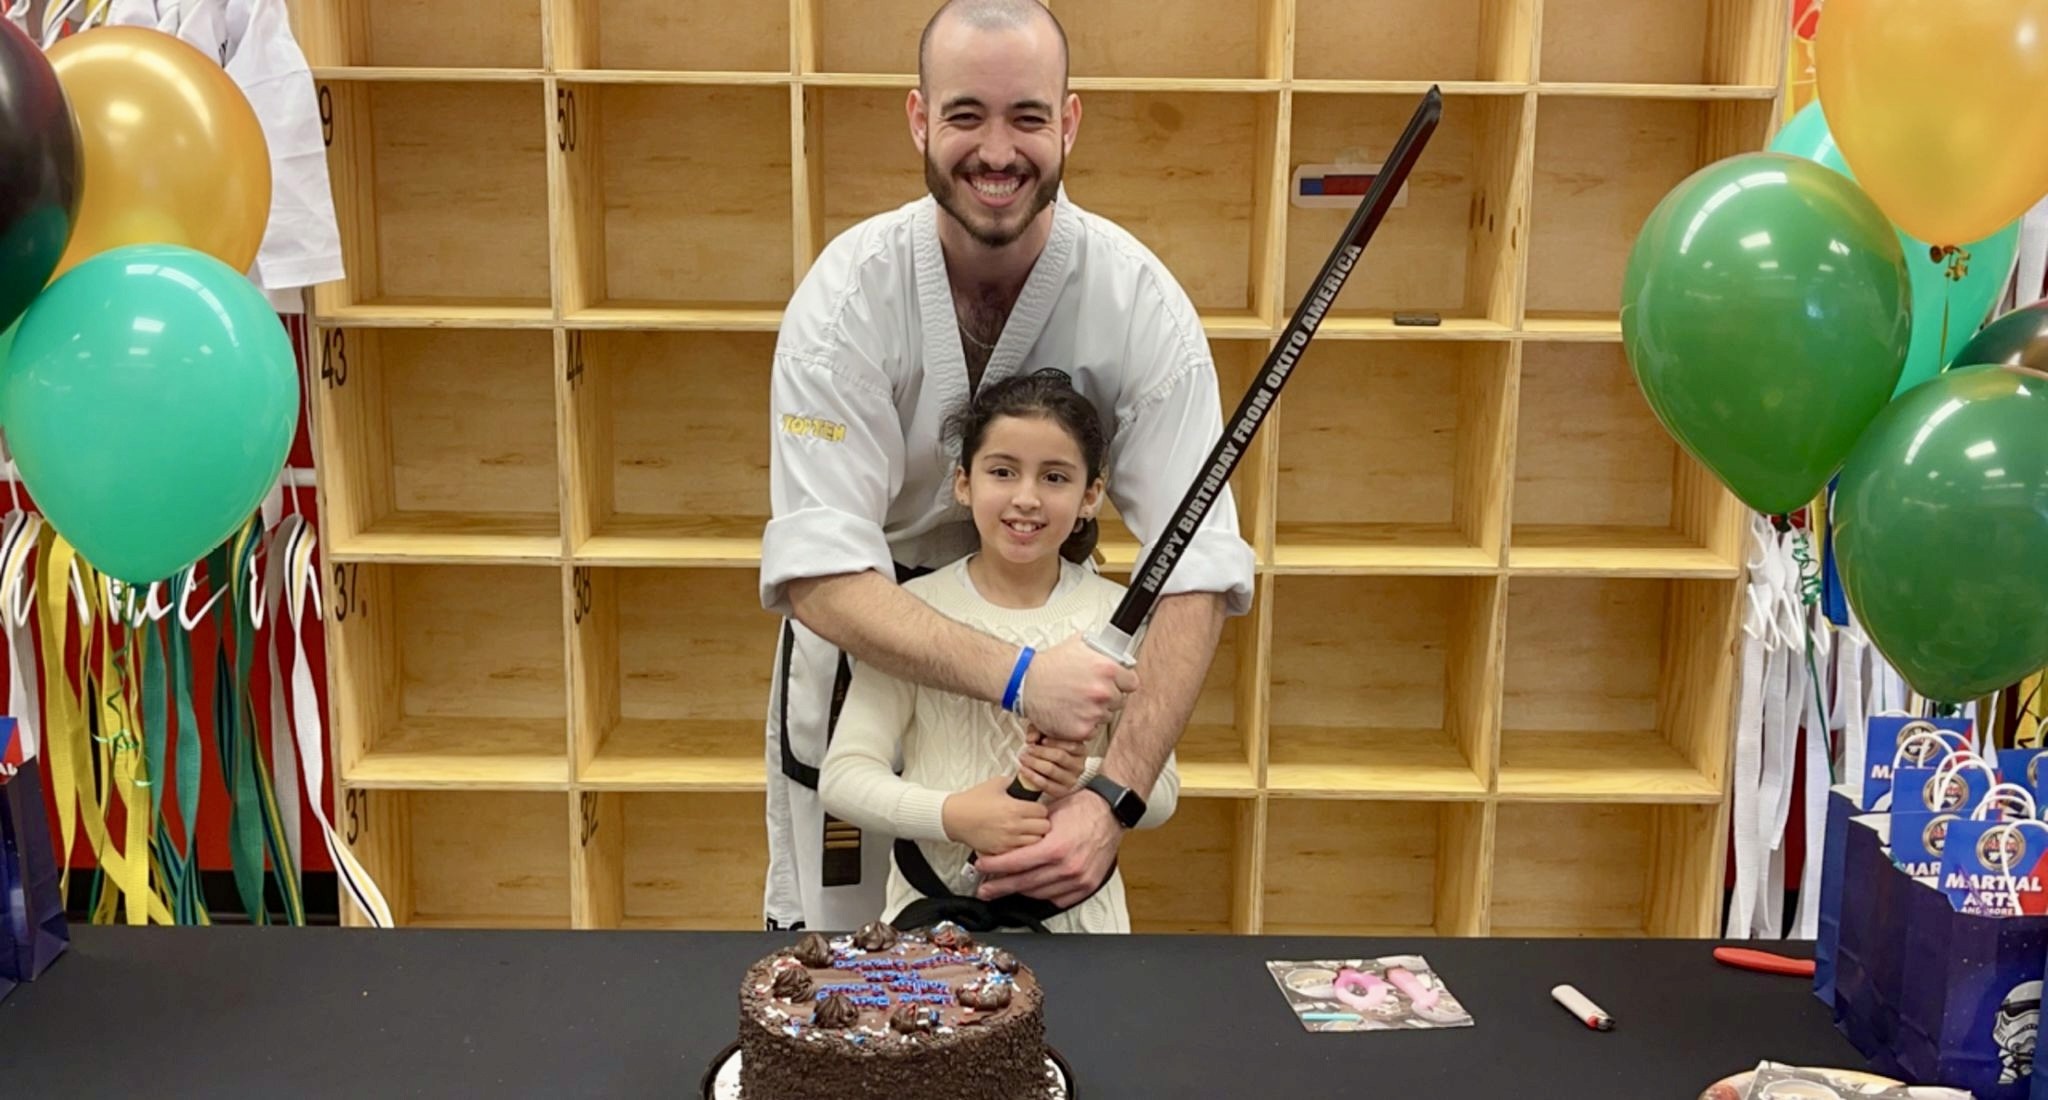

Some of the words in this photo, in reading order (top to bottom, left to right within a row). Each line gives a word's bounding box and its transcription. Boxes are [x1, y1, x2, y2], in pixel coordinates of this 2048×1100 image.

[557, 88, 577, 152] 50
[321, 328, 348, 390] 43
[566, 329, 584, 392] 44
[1142, 531, 1185, 593] HAPPY
[1177, 441, 1240, 534] BIRTHDAY
[1232, 387, 1273, 444] FROM
[1265, 329, 1309, 389] OKITO
[1300, 245, 1362, 331] AMERICA
[346, 788, 368, 846] 31
[1945, 873, 2043, 892] MARTIAL
